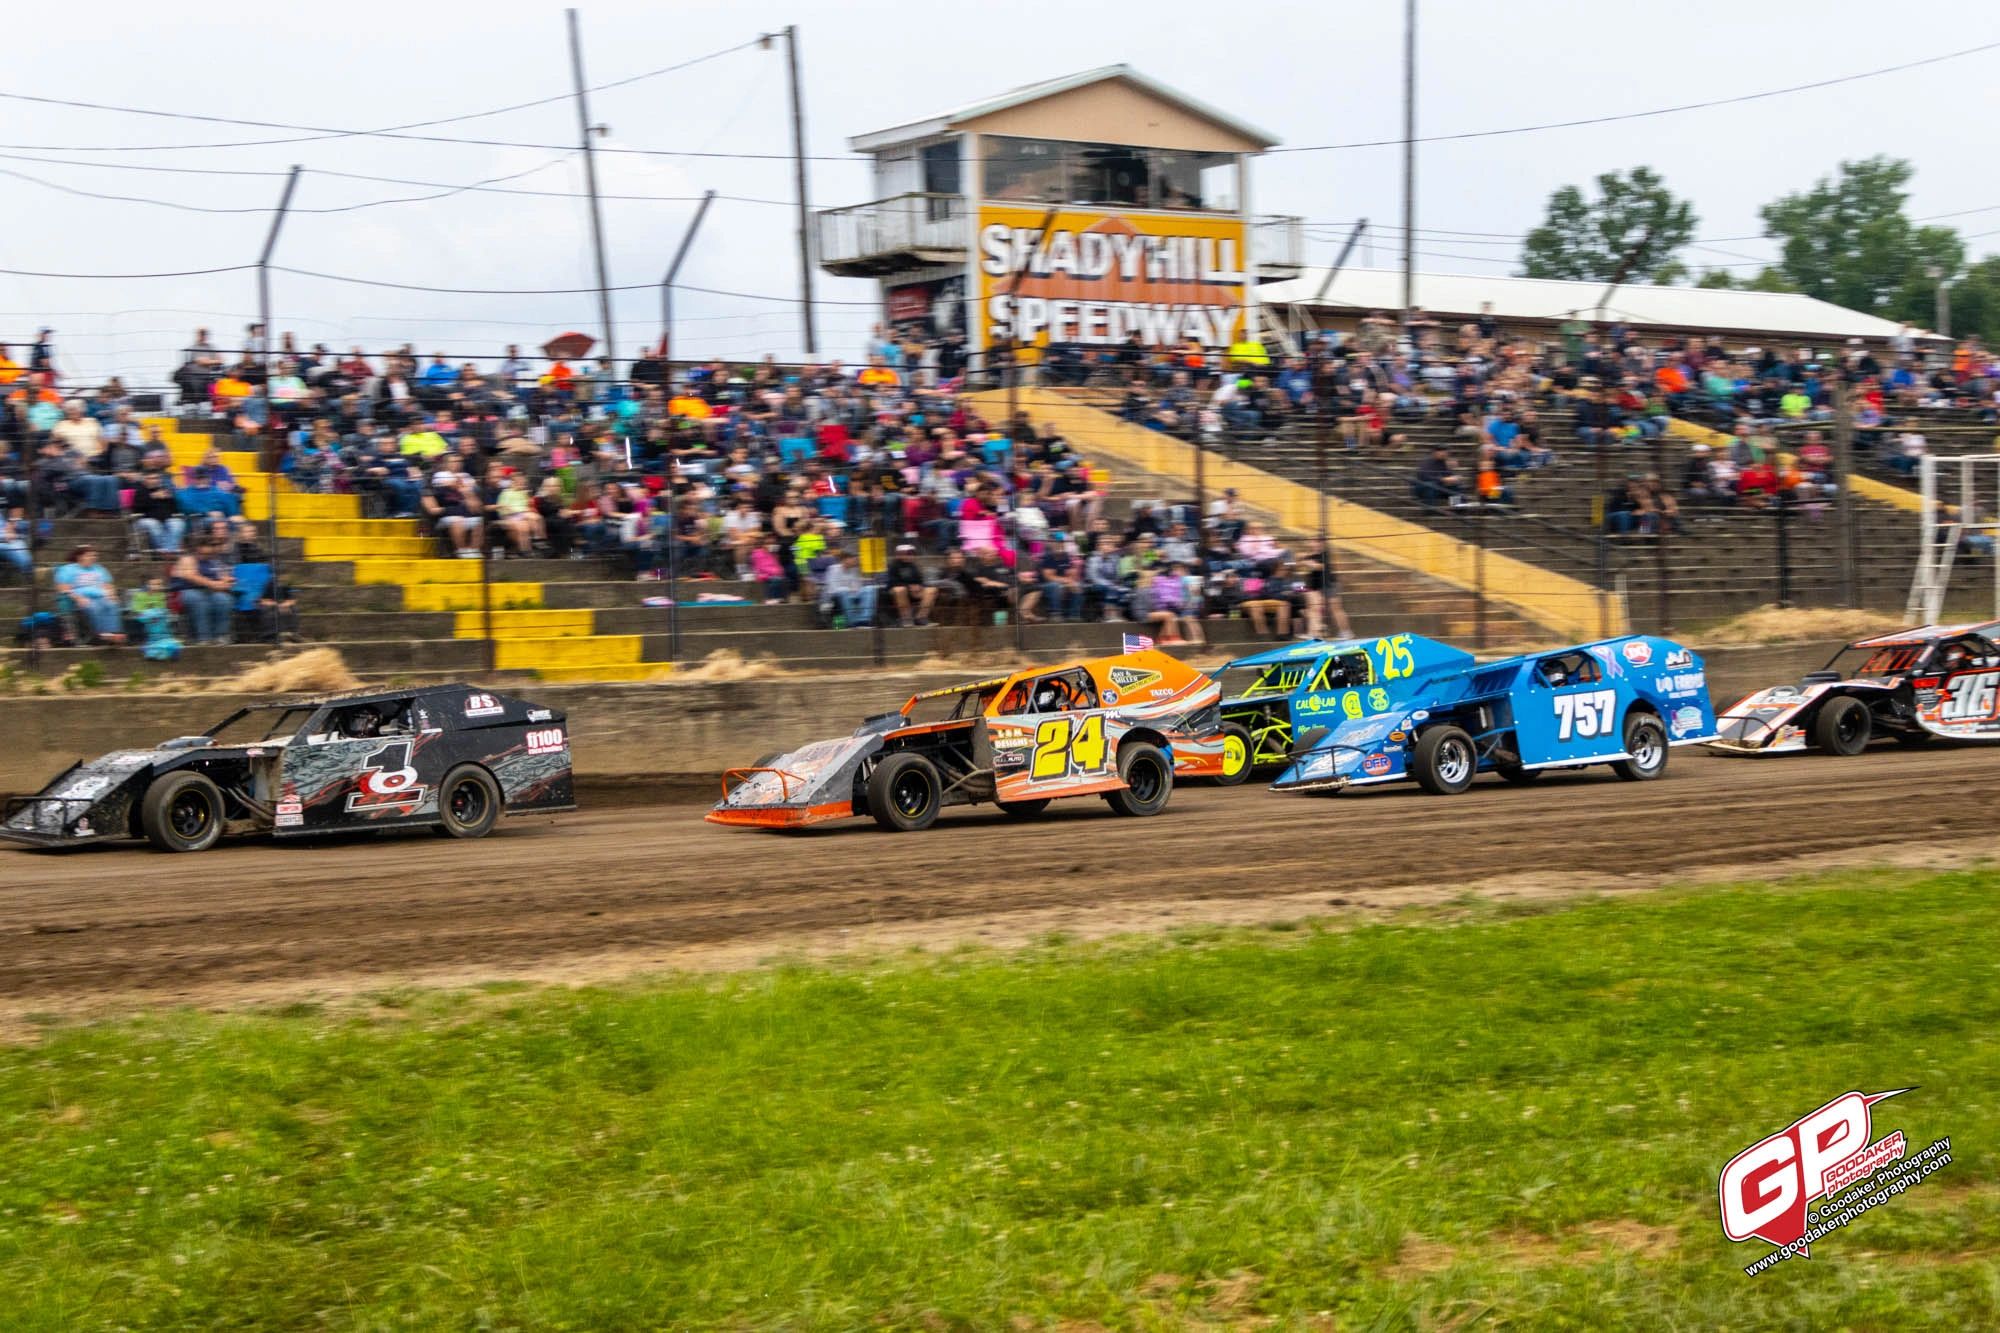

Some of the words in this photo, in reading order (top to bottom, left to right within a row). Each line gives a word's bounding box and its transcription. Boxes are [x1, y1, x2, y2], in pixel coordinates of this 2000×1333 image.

[980, 223, 1245, 287] SHADYHILL
[987, 294, 1244, 347] SPEEDWAY
[1553, 688, 1617, 742] 757
[1941, 672, 2000, 719] 36
[1030, 714, 1108, 782] 24
